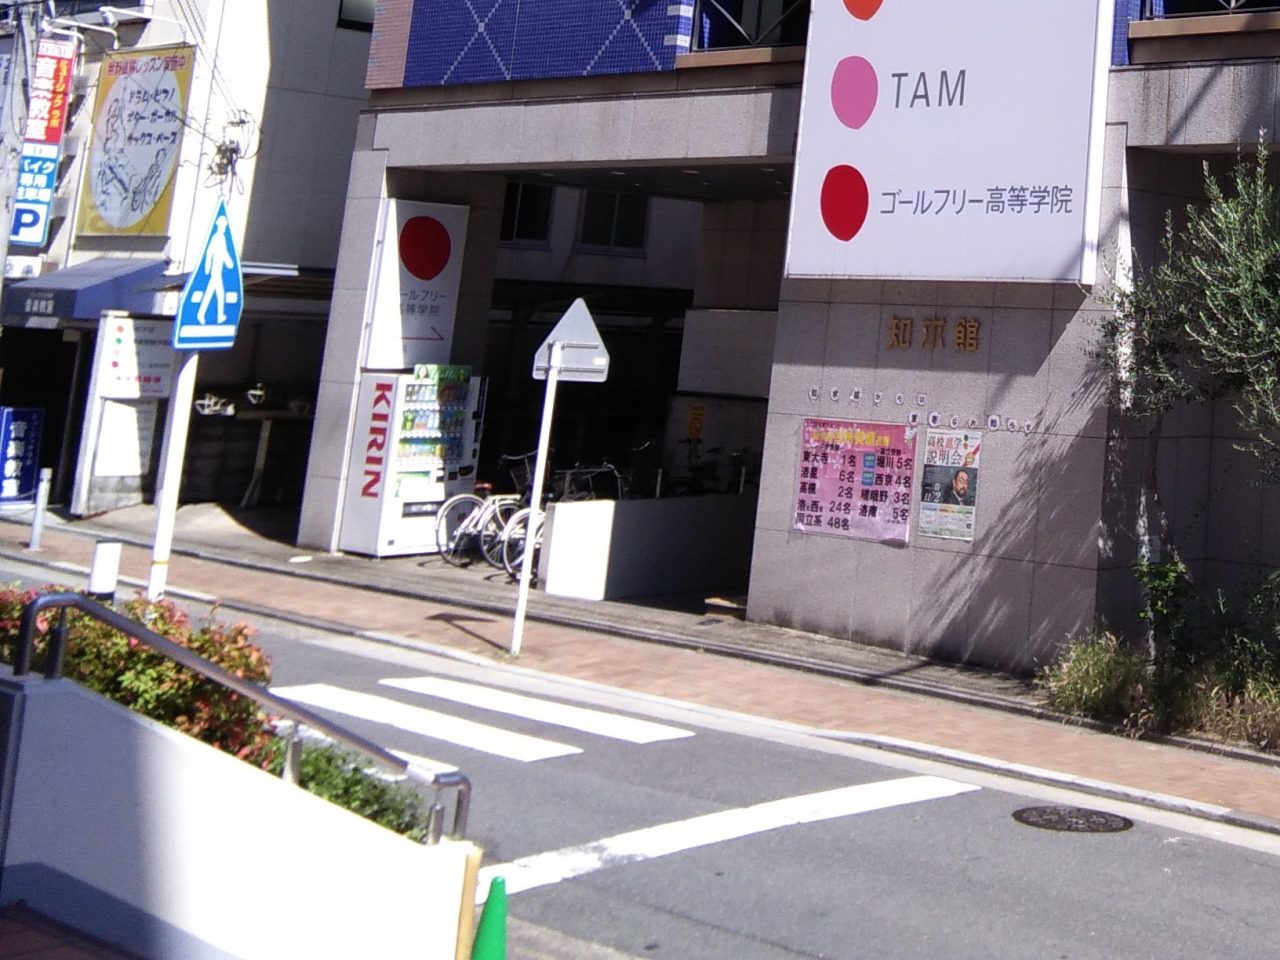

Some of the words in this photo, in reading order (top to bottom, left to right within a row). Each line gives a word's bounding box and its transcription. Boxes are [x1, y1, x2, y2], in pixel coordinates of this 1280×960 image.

[891, 69, 967, 109] TAM
[24, 56, 57, 140] 音楽教室
[879, 184, 1073, 215] ゴールフリー高等学院
[11, 207, 40, 237] P
[401, 288, 447, 302] ールフリー
[400, 302, 441, 317] 等学院
[887, 315, 981, 353] 知求館
[361, 382, 393, 499] KIRIN
[802, 451, 829, 465] 東大寺
[841, 454, 857, 468] 1名
[876, 456, 894, 469] 堀川
[896, 457, 913, 471] 5名
[926, 450, 962, 465] 説明会
[800, 466, 818, 479] 洛星
[838, 470, 855, 483] 6名
[874, 473, 893, 486] 西京
[895, 475, 912, 489] 4名
[837, 486, 854, 499] 2名
[893, 491, 910, 505] 3名
[829, 500, 852, 515] 24名
[858, 504, 878, 518] 洛南
[892, 507, 909, 521] 5名
[826, 516, 850, 531] 48名
